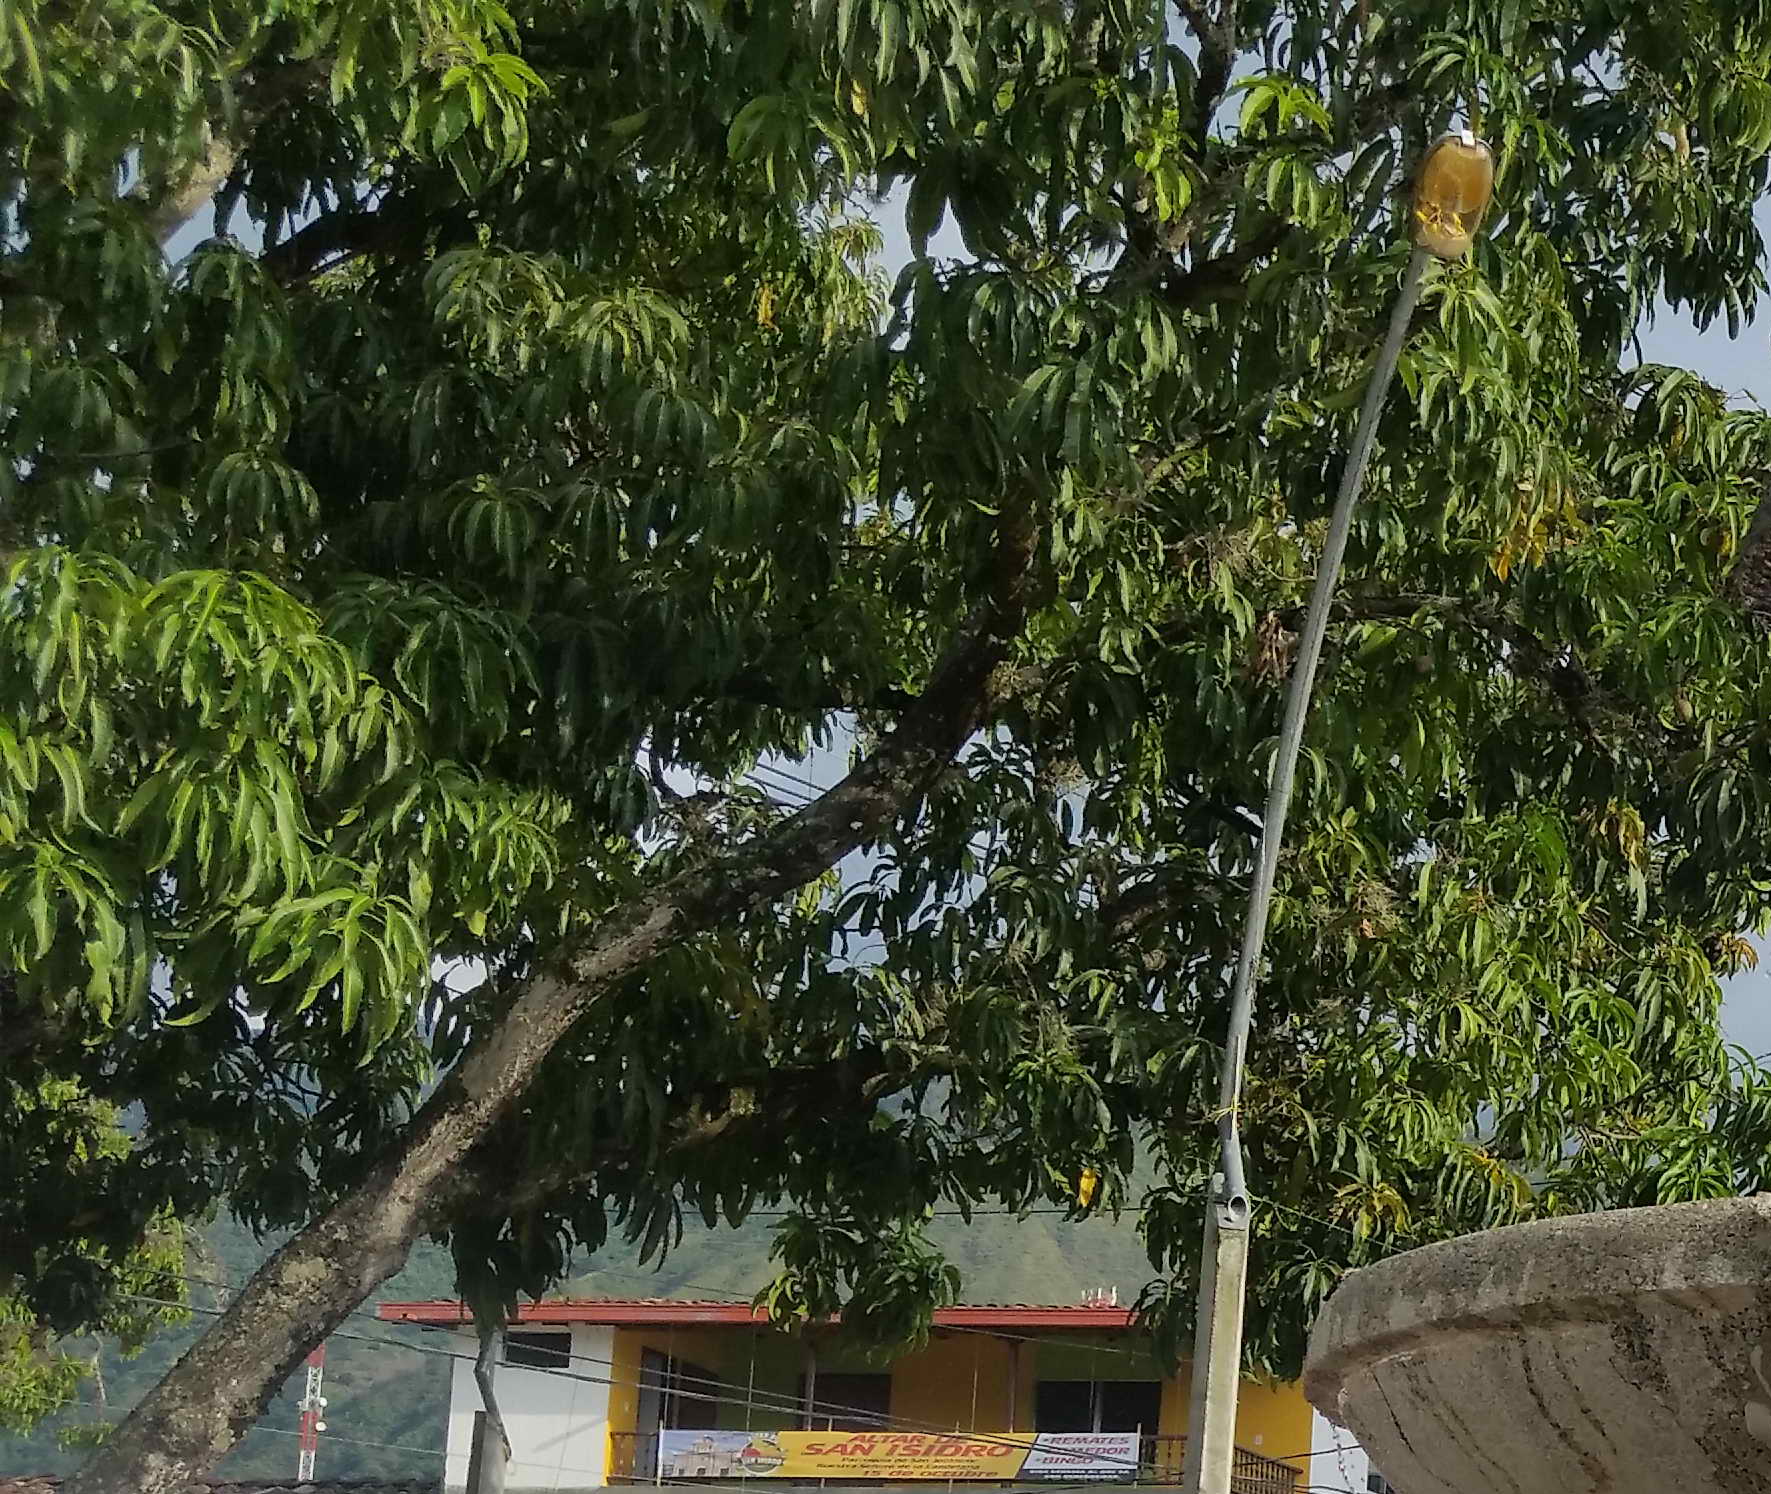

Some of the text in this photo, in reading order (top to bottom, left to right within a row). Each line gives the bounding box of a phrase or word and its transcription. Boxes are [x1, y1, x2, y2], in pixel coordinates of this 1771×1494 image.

[848, 1434, 926, 1444] ALTAR
[803, 1443, 1014, 1457] SAN ISIDRO
[920, 1470, 999, 1478] octubre
